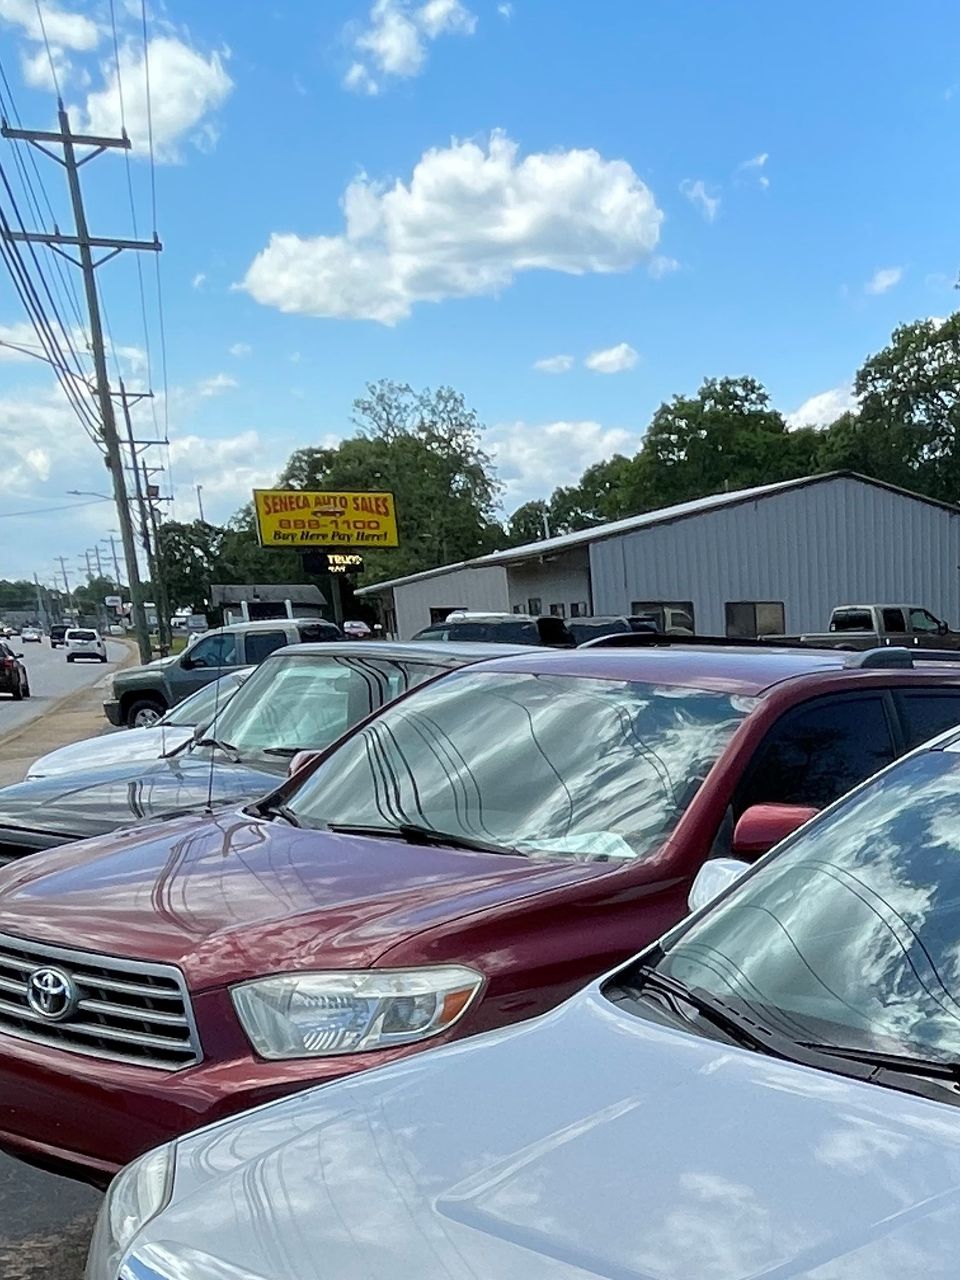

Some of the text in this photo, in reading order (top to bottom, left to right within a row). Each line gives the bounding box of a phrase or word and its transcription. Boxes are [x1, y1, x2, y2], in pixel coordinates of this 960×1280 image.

[263, 495, 390, 517] SENECA AUTO SALES
[278, 519, 381, 530] 888-1100
[272, 530, 388, 543] Buy Here Pay Here!
